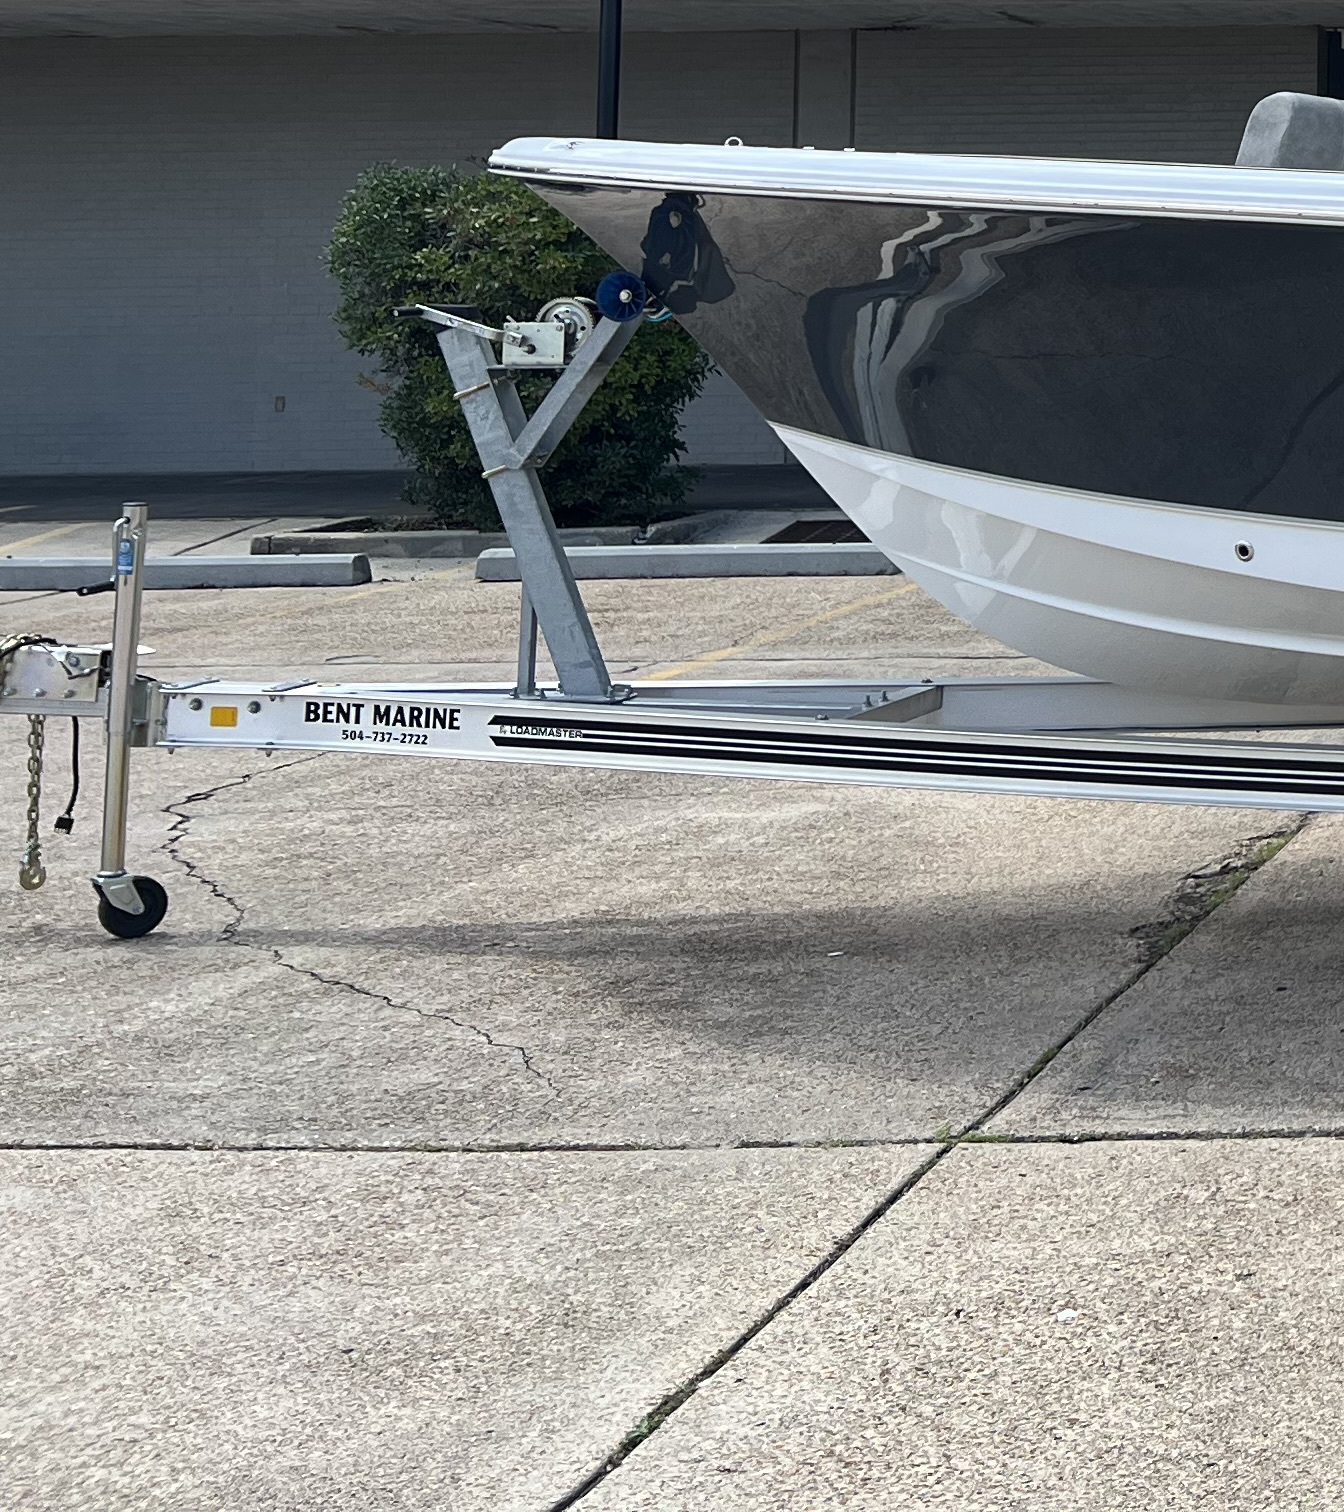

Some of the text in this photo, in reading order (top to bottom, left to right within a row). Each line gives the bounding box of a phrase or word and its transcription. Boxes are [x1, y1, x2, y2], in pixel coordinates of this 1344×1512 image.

[304, 701, 461, 730] BENT MARINE
[341, 729, 428, 745] 504-737-2722
[509, 724, 583, 739] LOADMASTER
